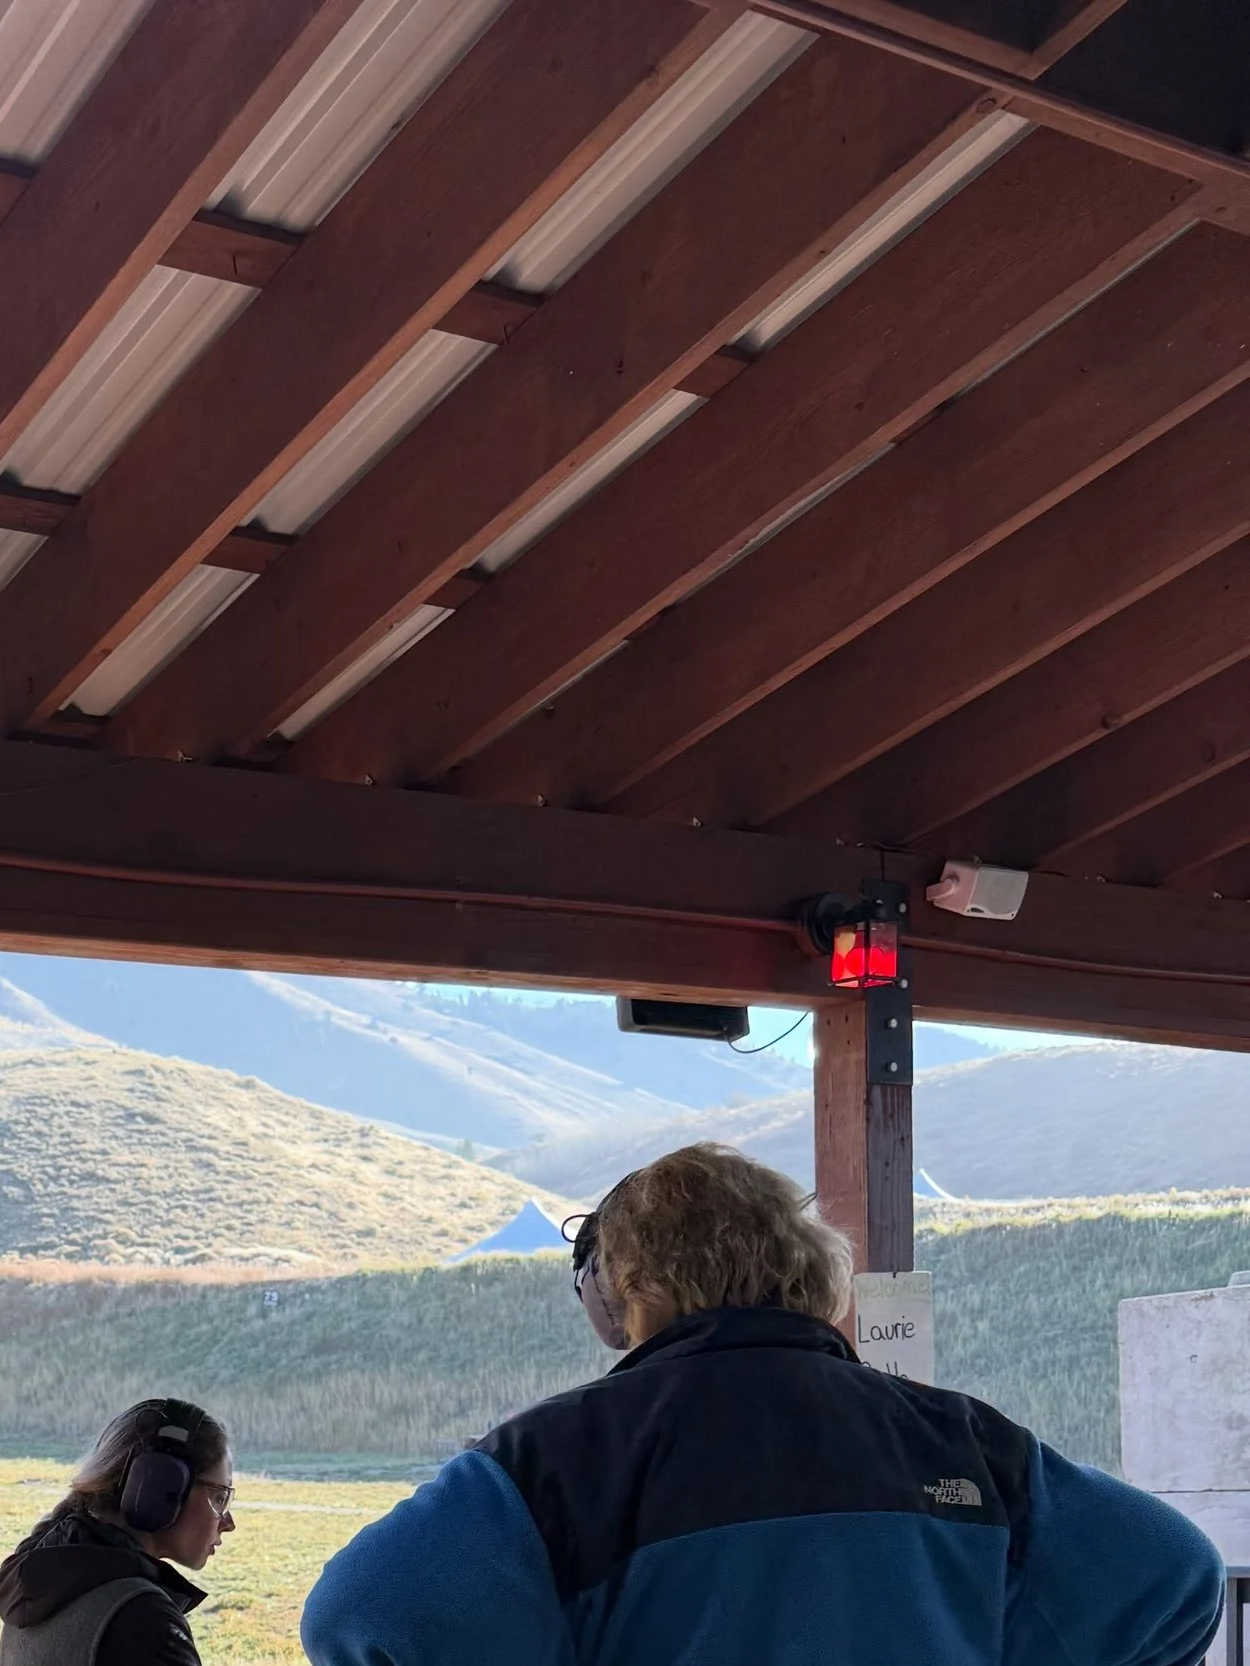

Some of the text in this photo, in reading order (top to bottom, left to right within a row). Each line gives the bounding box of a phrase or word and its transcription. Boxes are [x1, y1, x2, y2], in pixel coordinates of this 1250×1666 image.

[857, 1314, 915, 1343] Laurie
[938, 1479, 961, 1488] THE
[924, 1485, 964, 1496] NORTH
[934, 1495, 962, 1504] FACE
